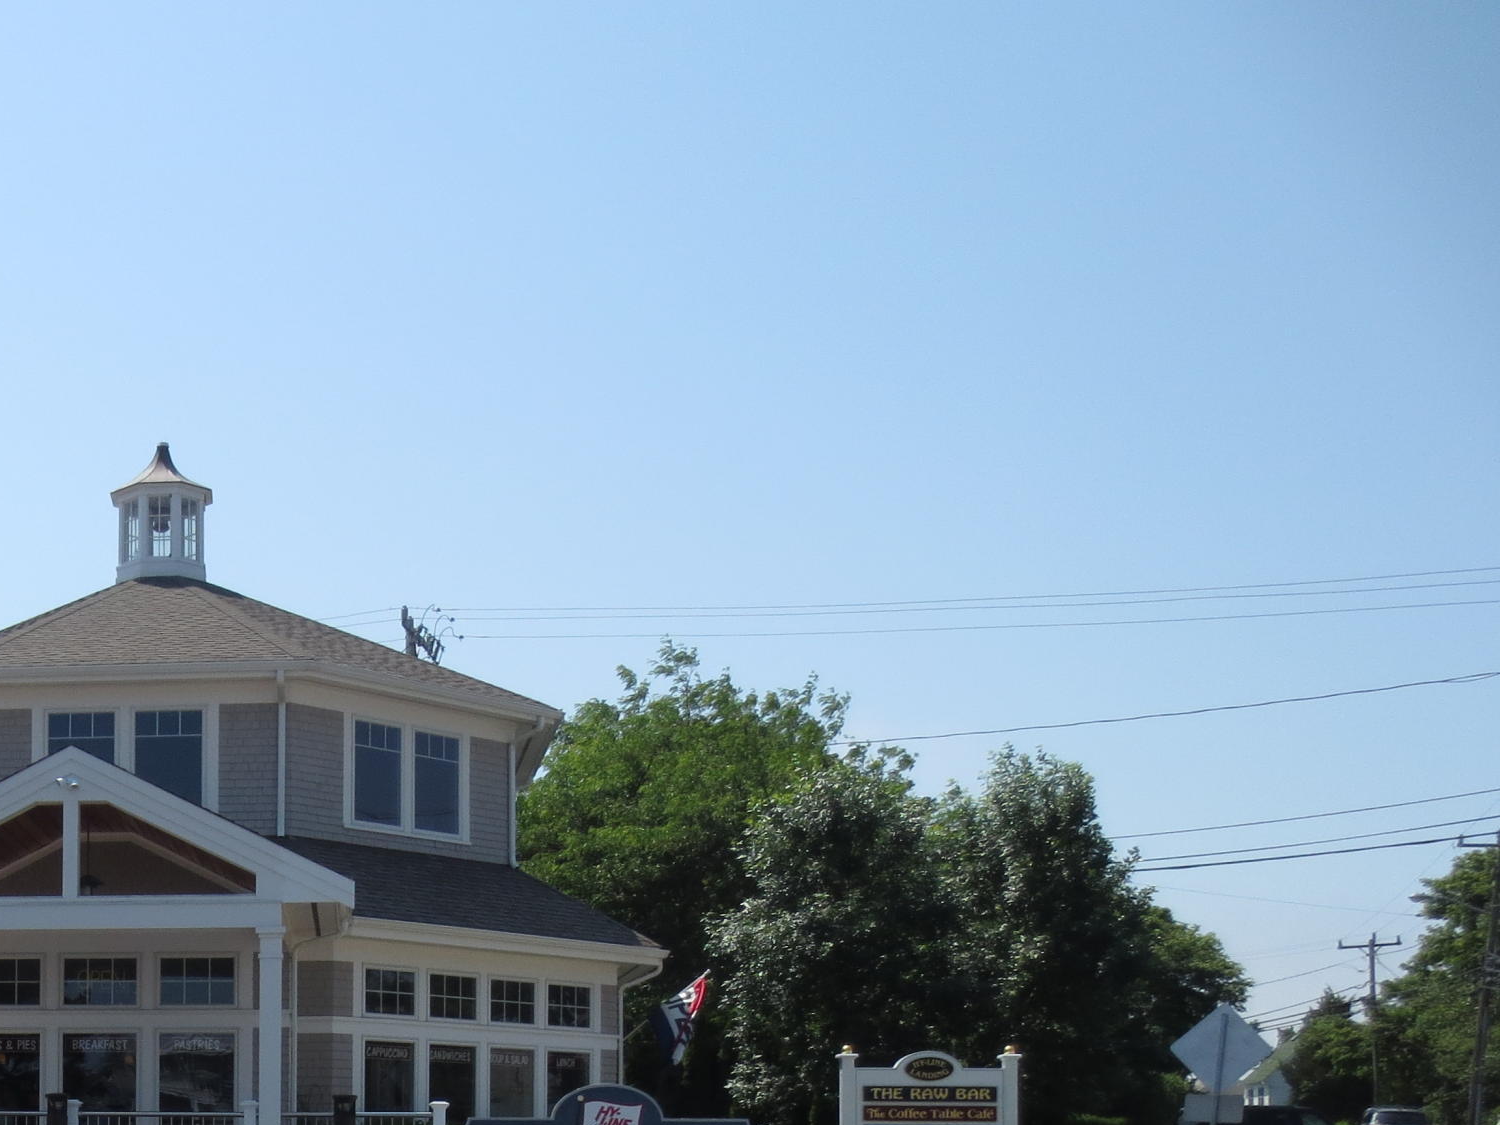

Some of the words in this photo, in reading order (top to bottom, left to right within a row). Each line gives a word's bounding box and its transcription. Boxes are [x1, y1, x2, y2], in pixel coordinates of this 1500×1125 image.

[5, 1039, 13, 1050] &
[17, 1039, 37, 1050] PIES
[72, 1039, 128, 1050] BREAKFAST
[173, 1039, 220, 1050] PASTRIES
[910, 1068, 949, 1079] LANDING
[870, 1087, 904, 1100] THE
[910, 1087, 948, 1100] RAW
[955, 1088, 991, 1100] BAR
[867, 1107, 885, 1119] The
[888, 1107, 927, 1119] Coffee
[930, 1108, 964, 1119] Table
